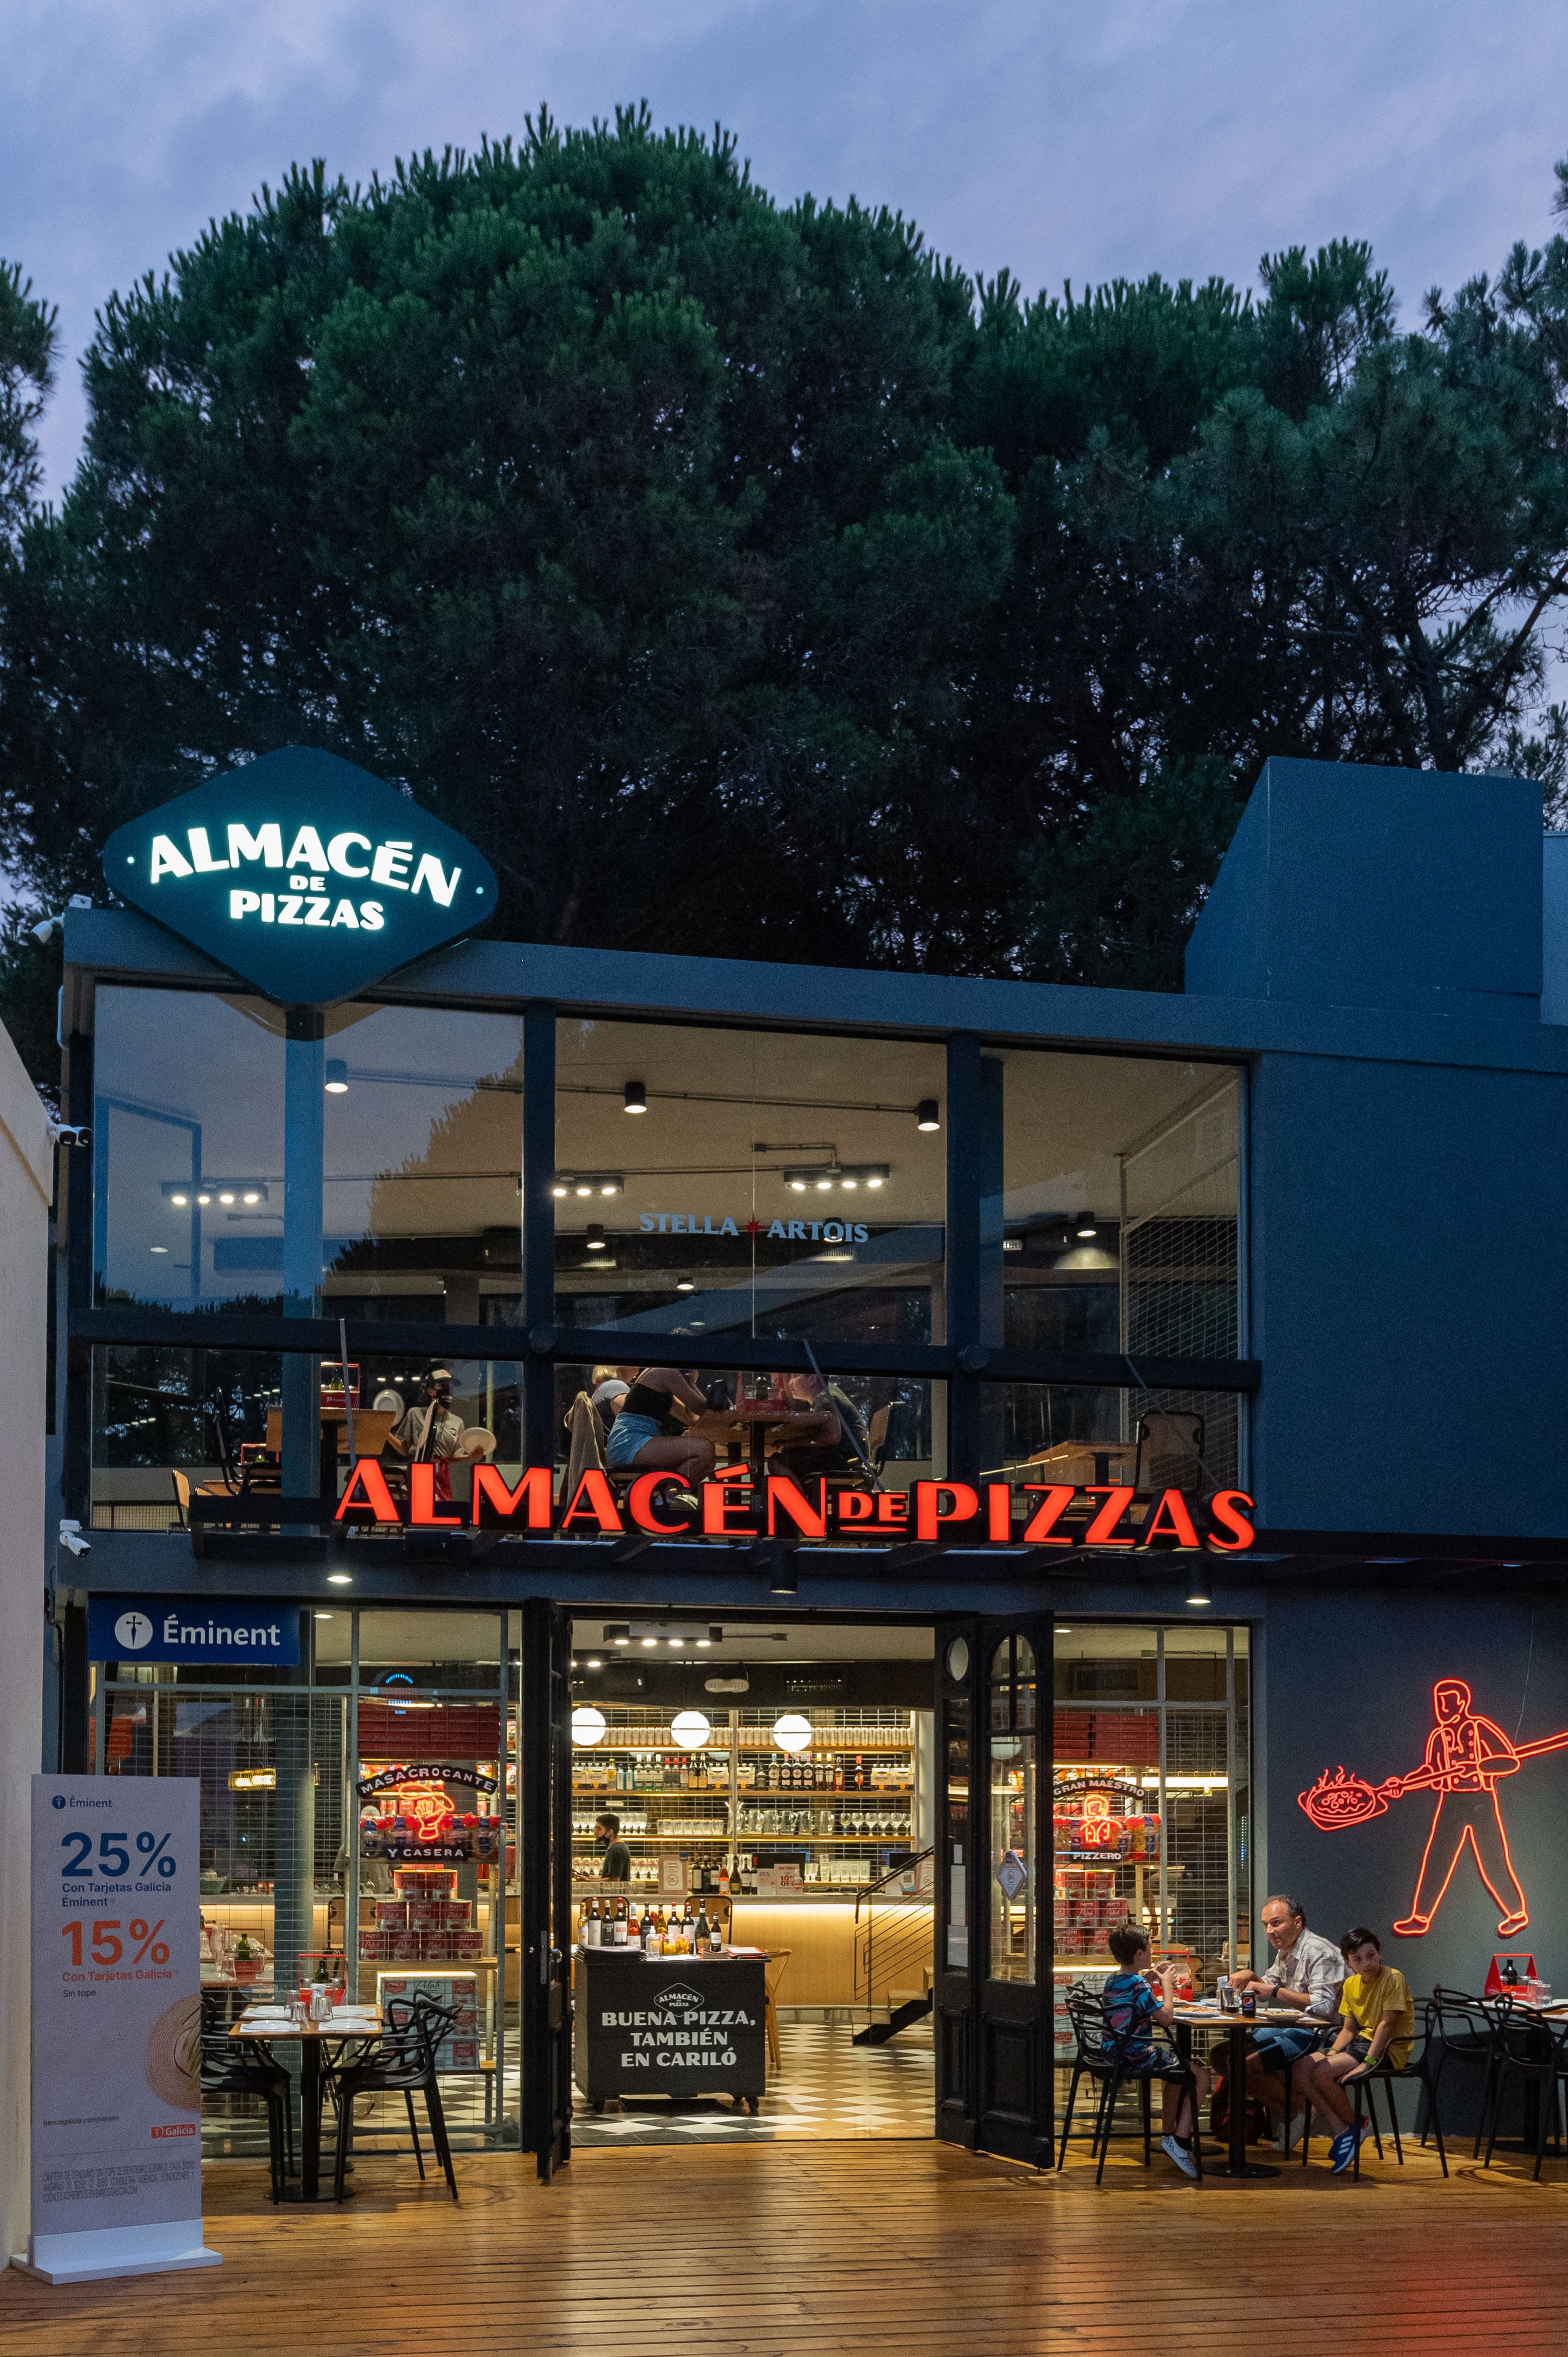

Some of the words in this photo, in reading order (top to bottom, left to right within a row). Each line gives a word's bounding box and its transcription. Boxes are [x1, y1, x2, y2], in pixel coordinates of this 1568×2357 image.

[151, 824, 461, 907] ALMACÉN
[290, 875, 326, 891] DE
[230, 890, 384, 930] PIZZAS
[640, 1212, 739, 1236] STELLA
[767, 1220, 869, 1243] ARTOIS
[335, 1459, 826, 1537] ALMACÉN
[839, 1492, 907, 1522] DE
[917, 1482, 1255, 1550] PIZZAS
[164, 1614, 280, 1646] Éminent
[361, 1771, 406, 1794] MASA
[408, 1767, 495, 1791] CROCANTE
[1053, 1781, 1086, 1796] GRAN
[1088, 1780, 1145, 1797] MAESTRO
[69, 1796, 113, 1808] Éminent
[61, 1831, 177, 1878] 25%
[387, 1849, 398, 1857] Y
[403, 1848, 463, 1857] CASERA
[62, 1883, 85, 1893] Con
[88, 1882, 132, 1894] Tarjetas
[134, 1882, 172, 1892] Galicia
[62, 1894, 108, 1907] Éminent
[61, 1919, 170, 1966] 15%
[62, 1972, 86, 1982] Con
[88, 1971, 133, 1983] Tarjetas
[135, 1969, 173, 1980] Galicia
[62, 1990, 75, 1998] Sin
[77, 1990, 98, 1998] tope.
[659, 1994, 699, 2003] ALMACÉN
[601, 2011, 677, 2026] BUENA
[683, 2011, 756, 2026] PIZZA,
[630, 2027, 728, 2046] TAMBIÉN
[621, 2052, 650, 2067] EN
[656, 2046, 737, 2067] CARILÓ
[166, 2126, 194, 2136] Galicia
